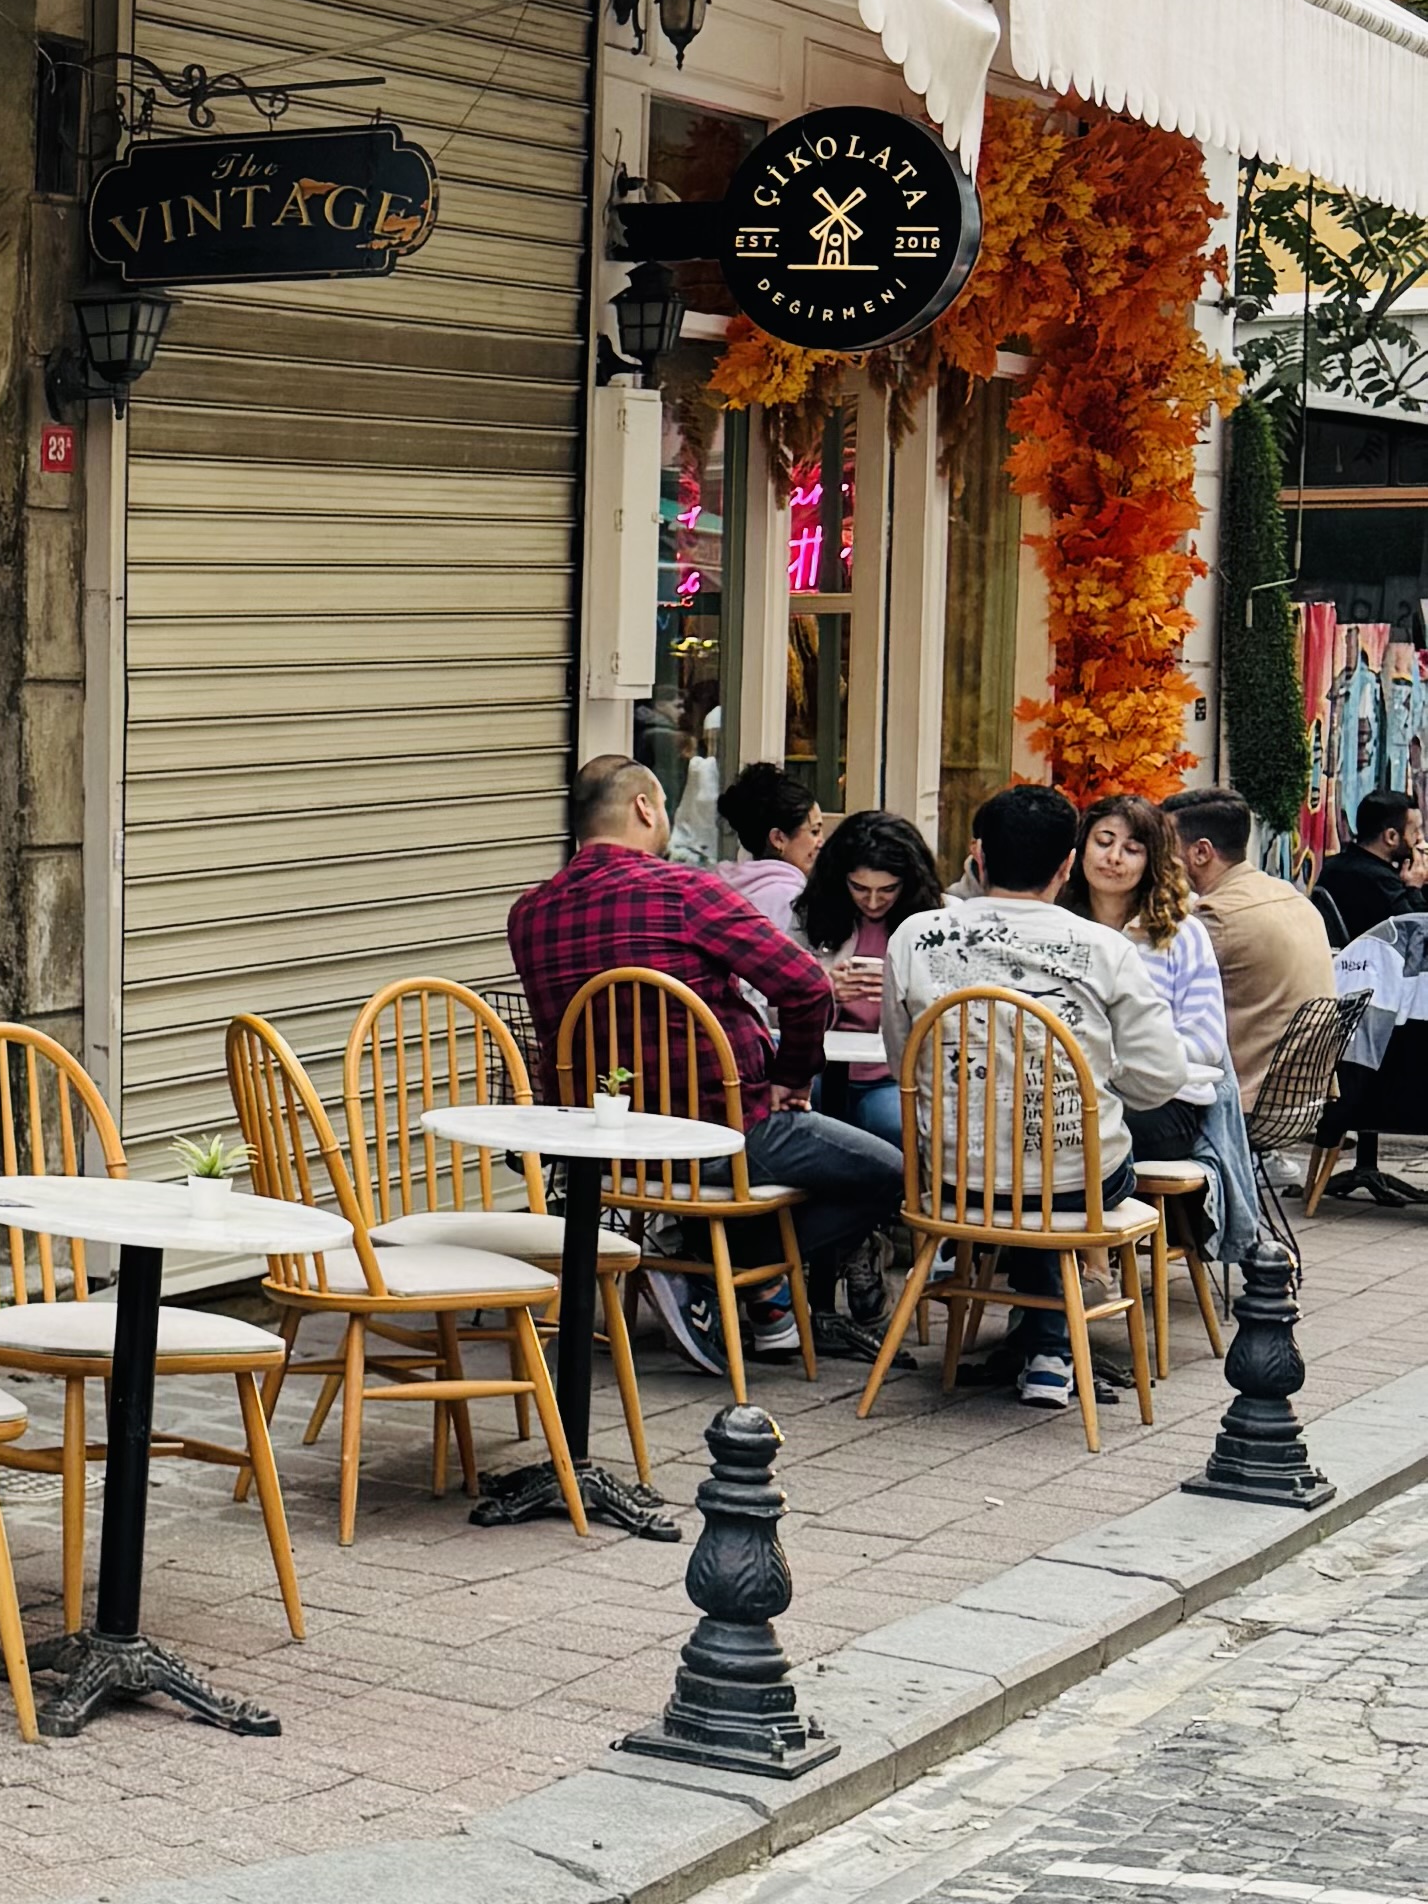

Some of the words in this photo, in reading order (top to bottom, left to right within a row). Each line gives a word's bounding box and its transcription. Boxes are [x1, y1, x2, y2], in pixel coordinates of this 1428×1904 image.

[211, 152, 283, 180] The
[753, 134, 928, 210] ÇİKOLATA
[108, 180, 413, 253] VINTAGE
[735, 235, 780, 248] EST.
[895, 236, 941, 249] 2018
